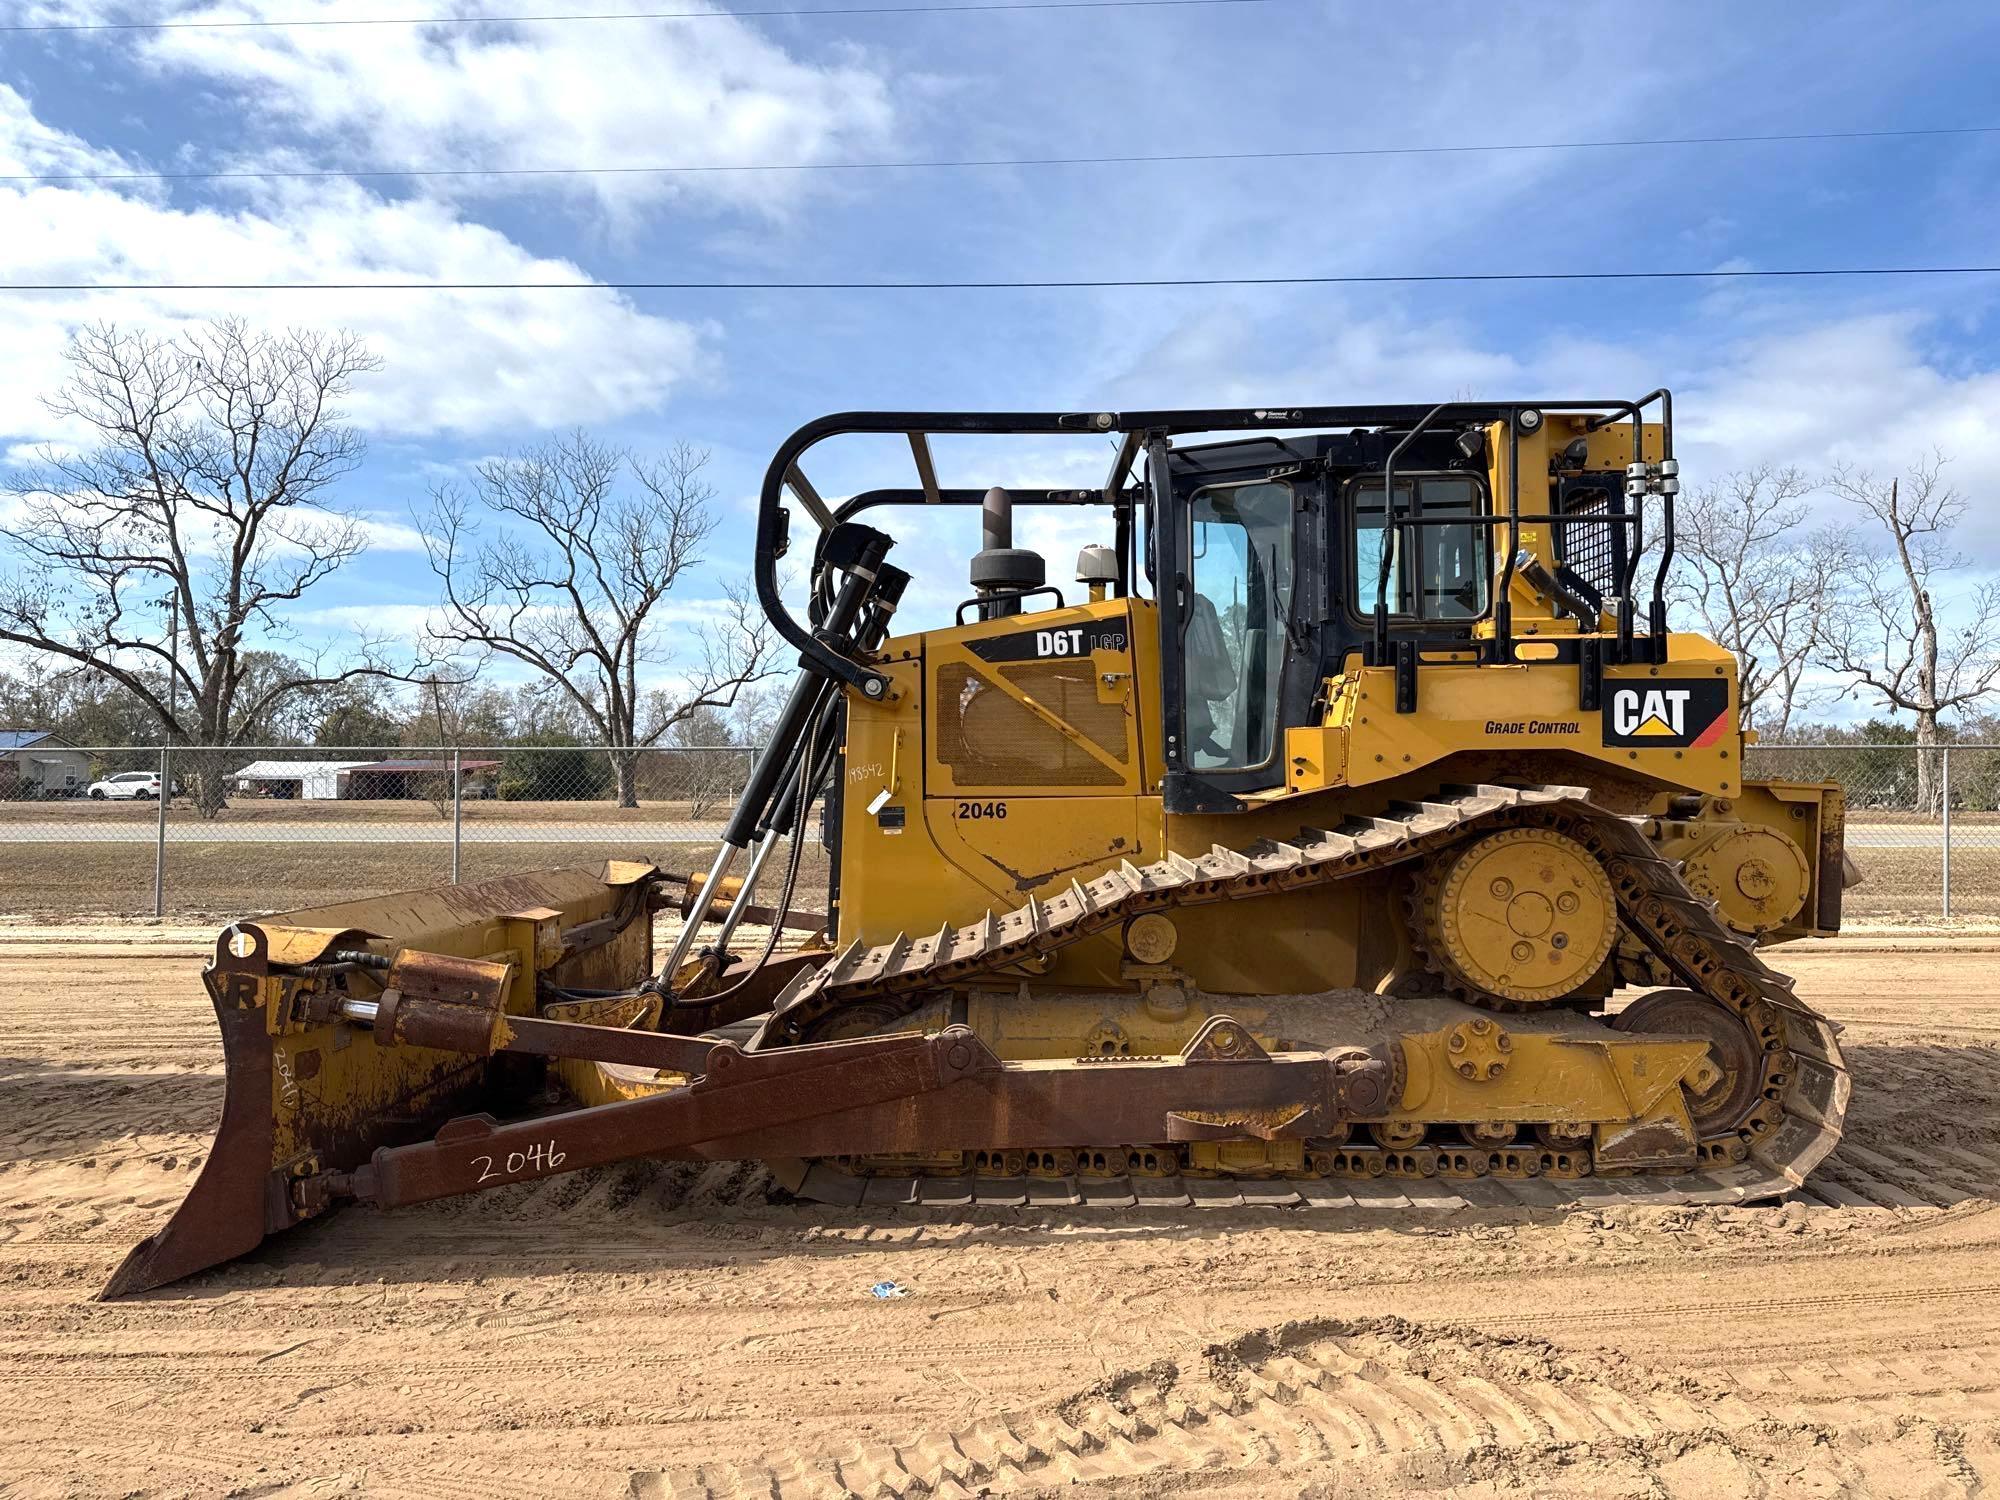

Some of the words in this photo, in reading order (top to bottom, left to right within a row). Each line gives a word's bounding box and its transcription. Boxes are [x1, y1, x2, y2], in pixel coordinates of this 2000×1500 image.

[1036, 629, 1083, 656] D6T
[1613, 689, 1690, 736] CAT
[848, 762, 885, 785] 198542
[958, 802, 1007, 819] 2046
[470, 1139, 566, 1183] 2046
